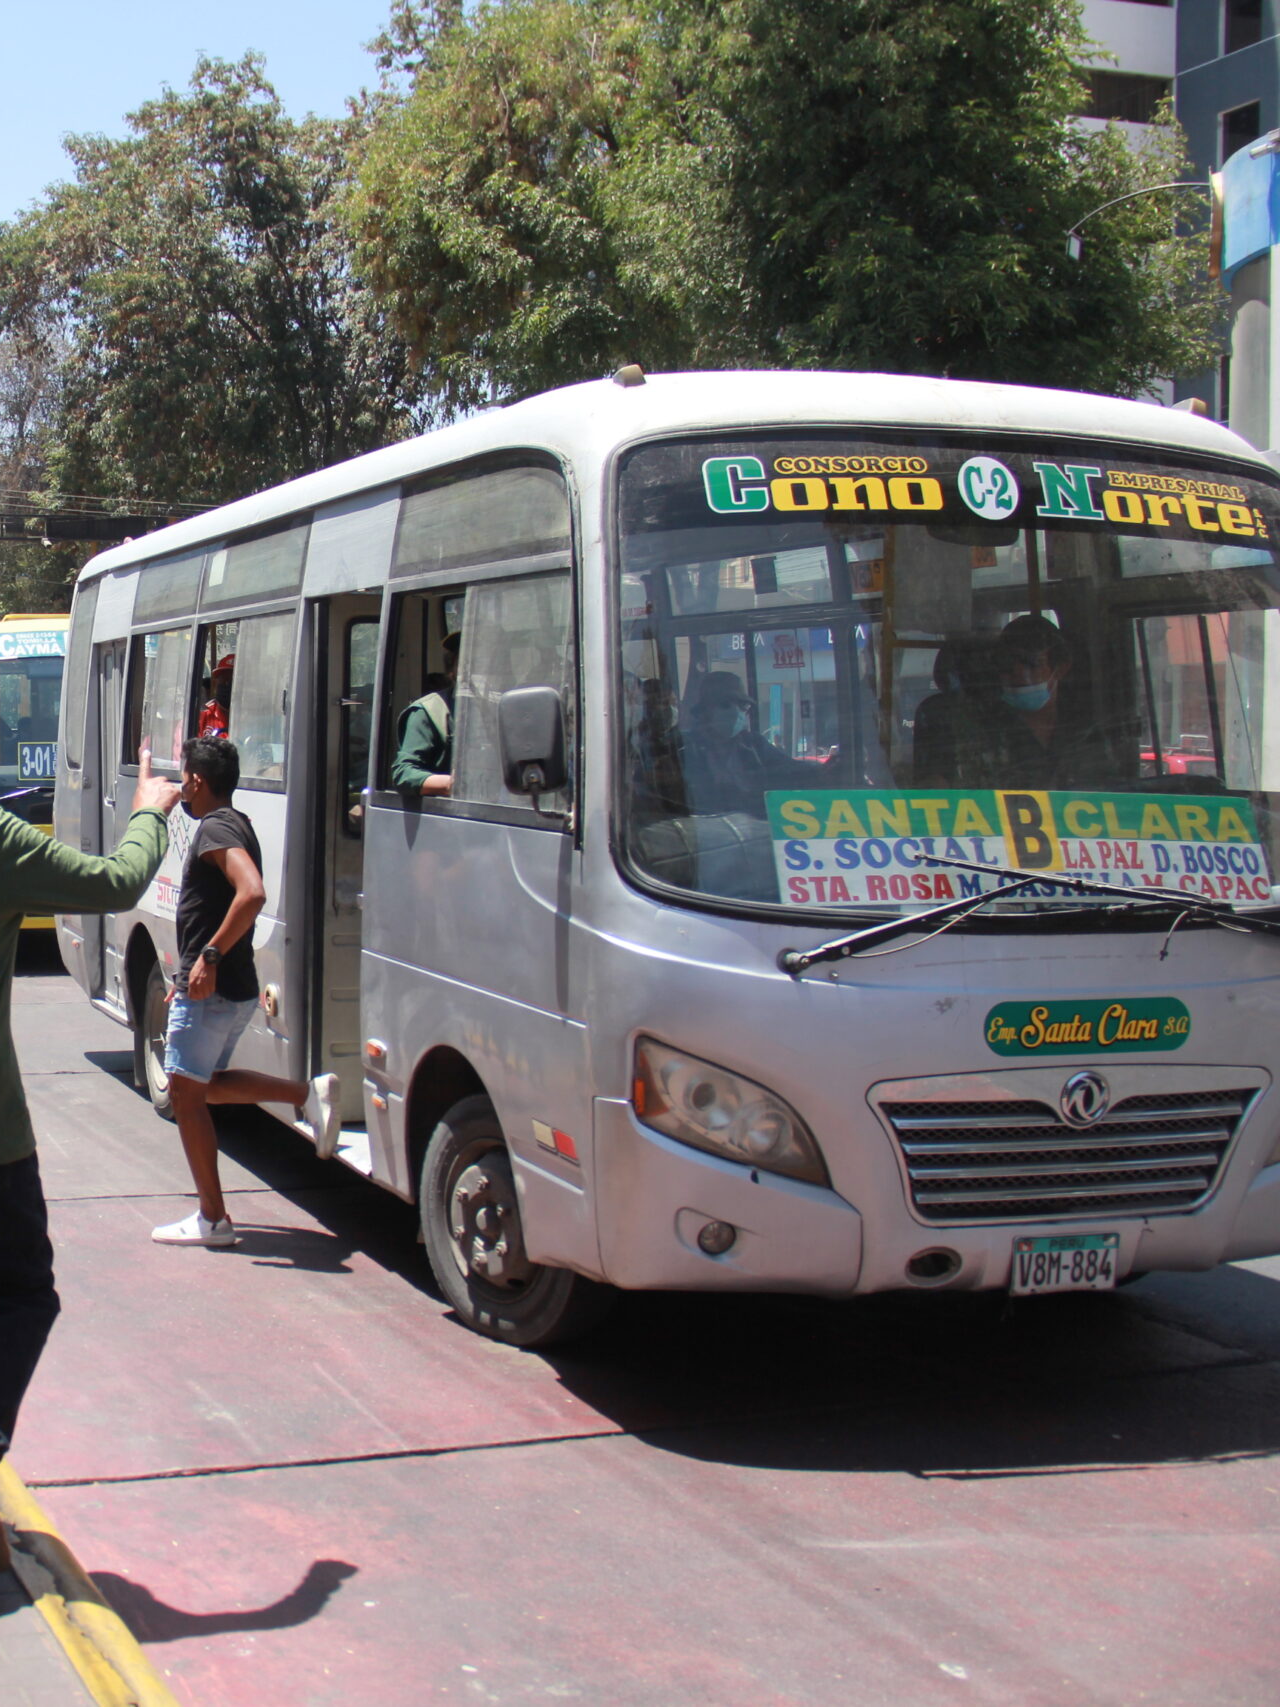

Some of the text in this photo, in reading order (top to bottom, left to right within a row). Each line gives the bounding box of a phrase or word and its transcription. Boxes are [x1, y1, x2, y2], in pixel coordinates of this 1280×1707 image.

[774, 456, 928, 475] CONSORCIO
[702, 456, 1256, 537] Cono C-2 Norte
[1107, 471, 1245, 502] EMPRESARIAL
[22, 746, 51, 776] 3-01
[780, 794, 1255, 868] SANTA B CLARA
[784, 837, 1260, 874] S. SOCIAL LA PAZ D. BOSCO
[788, 876, 859, 903] STA.
[866, 873, 955, 900] ROSA
[1179, 875, 1270, 901] CAPAC
[987, 1017, 1018, 1045] Emp.
[1020, 1006, 1092, 1048] Santa
[1097, 1003, 1158, 1046] Clara
[1049, 1239, 1086, 1250] PERU
[1019, 1249, 1112, 1287] V8M-884
